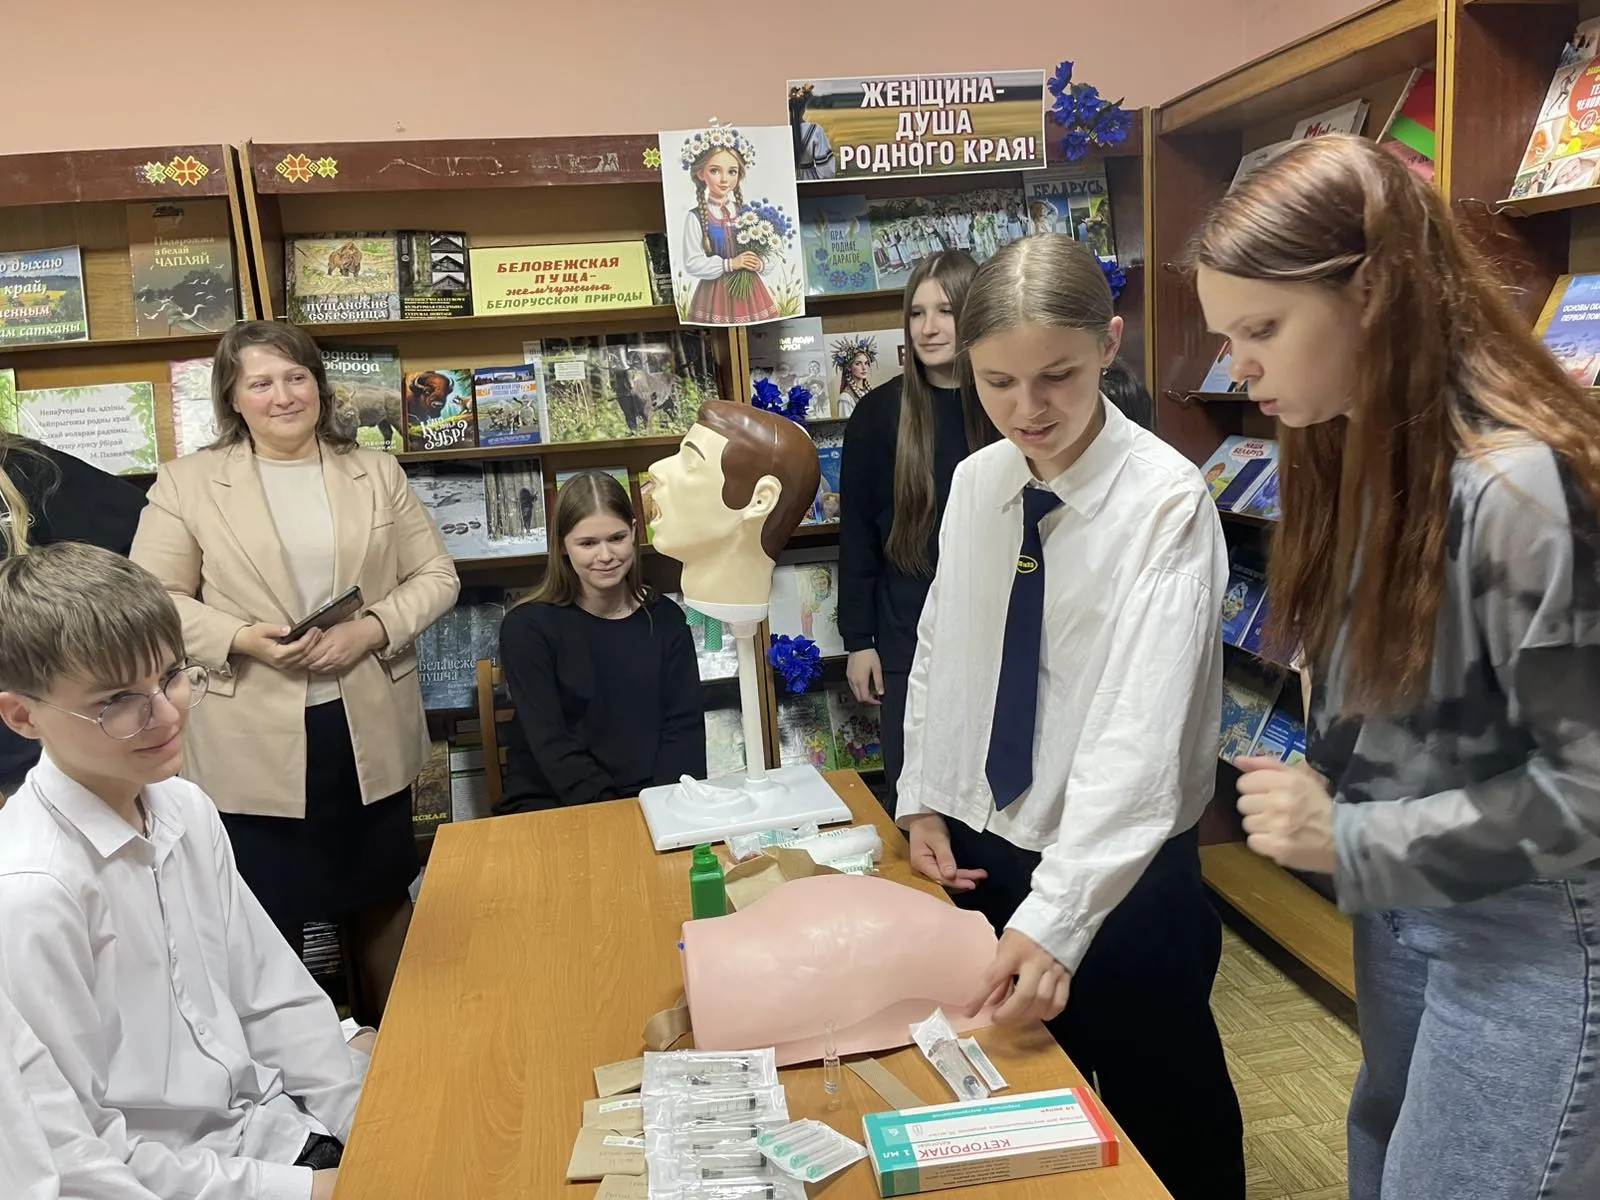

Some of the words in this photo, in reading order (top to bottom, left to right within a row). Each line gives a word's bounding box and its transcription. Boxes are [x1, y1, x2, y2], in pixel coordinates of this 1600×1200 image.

[861, 78, 1004, 108] ЖЕНЩИНА-
[896, 111, 972, 140] ДУША
[840, 141, 953, 172] РОДНОГО
[964, 137, 1035, 164] КРАЯ!
[830, 230, 844, 241] ПРА
[161, 246, 190, 255] белай
[831, 241, 857, 253] РОДНАЕ
[12, 257, 63, 272] дыхаю
[155, 252, 210, 267] ЧАПЛЯЙ
[497, 257, 619, 273] БЕЛОВЕЖСКАЯ
[4, 280, 47, 299] край,
[506, 284, 612, 296] жемчужина
[306, 301, 388, 312] ПУЩАНСКИЕ
[487, 294, 579, 309] БЕЛОРУССКОЙ
[585, 292, 643, 304] ПРИРОДЫ
[308, 310, 387, 321] СОКРОВИЩА
[20, 322, 80, 337] сатканы
[321, 350, 369, 363] одная
[424, 420, 468, 450] ЗУБР?
[919, 1138, 1011, 1158] КЕТОРОЛАК
